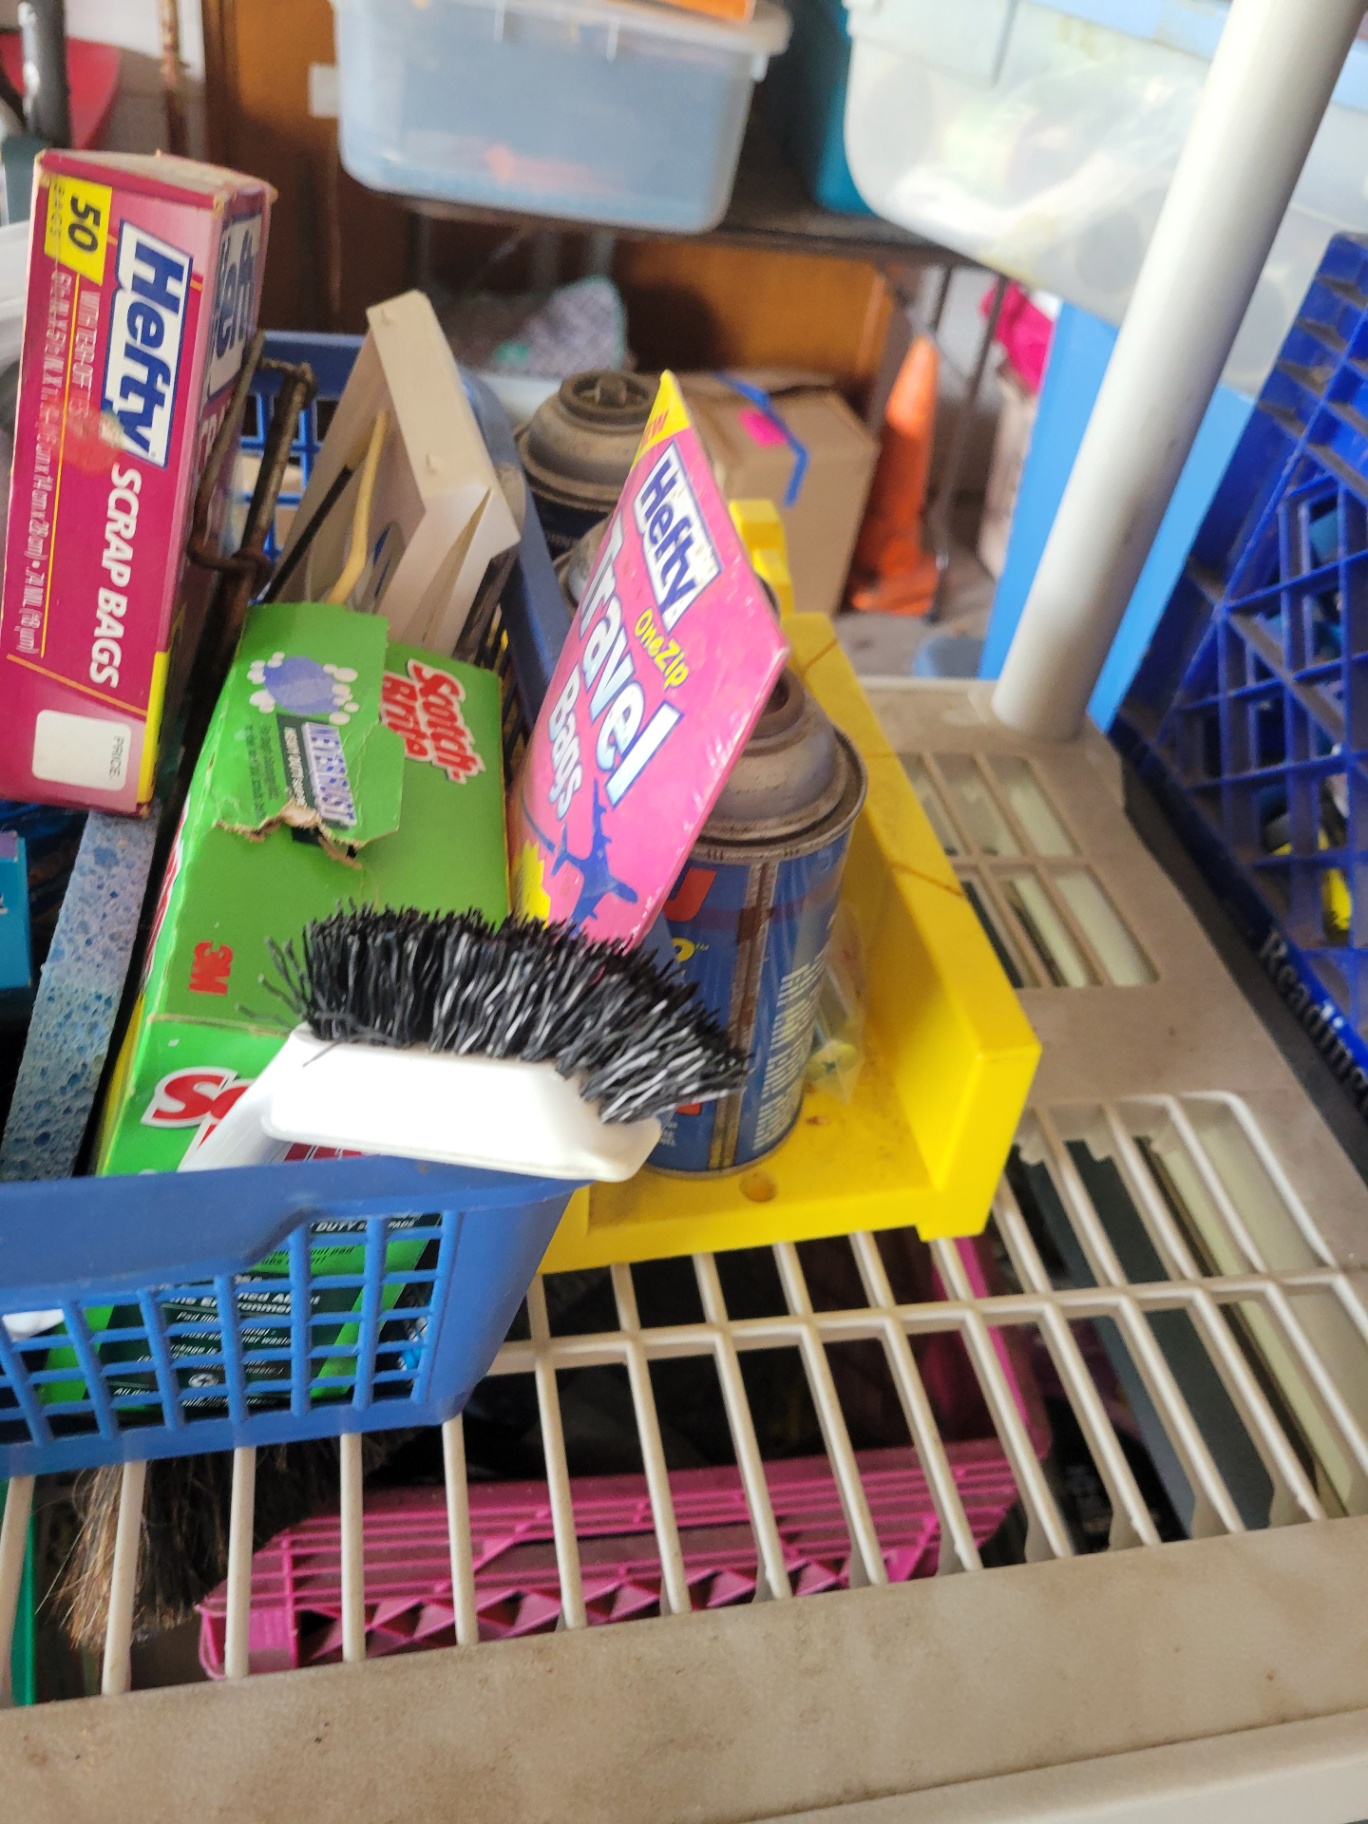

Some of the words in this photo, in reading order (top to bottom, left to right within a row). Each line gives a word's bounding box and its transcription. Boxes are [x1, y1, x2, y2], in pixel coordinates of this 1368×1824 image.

[68, 196, 101, 253] 50
[102, 238, 187, 458] Hefty
[101, 464, 142, 586] SCRAP
[638, 457, 699, 618] Hefty
[88, 588, 127, 686] BAGS
[579, 508, 685, 810] Travel
[108, 734, 126, 779] PRICE
[548, 661, 582, 820] Bags
[188, 941, 234, 996] 3M
[315, 1221, 358, 1233] DUTY
